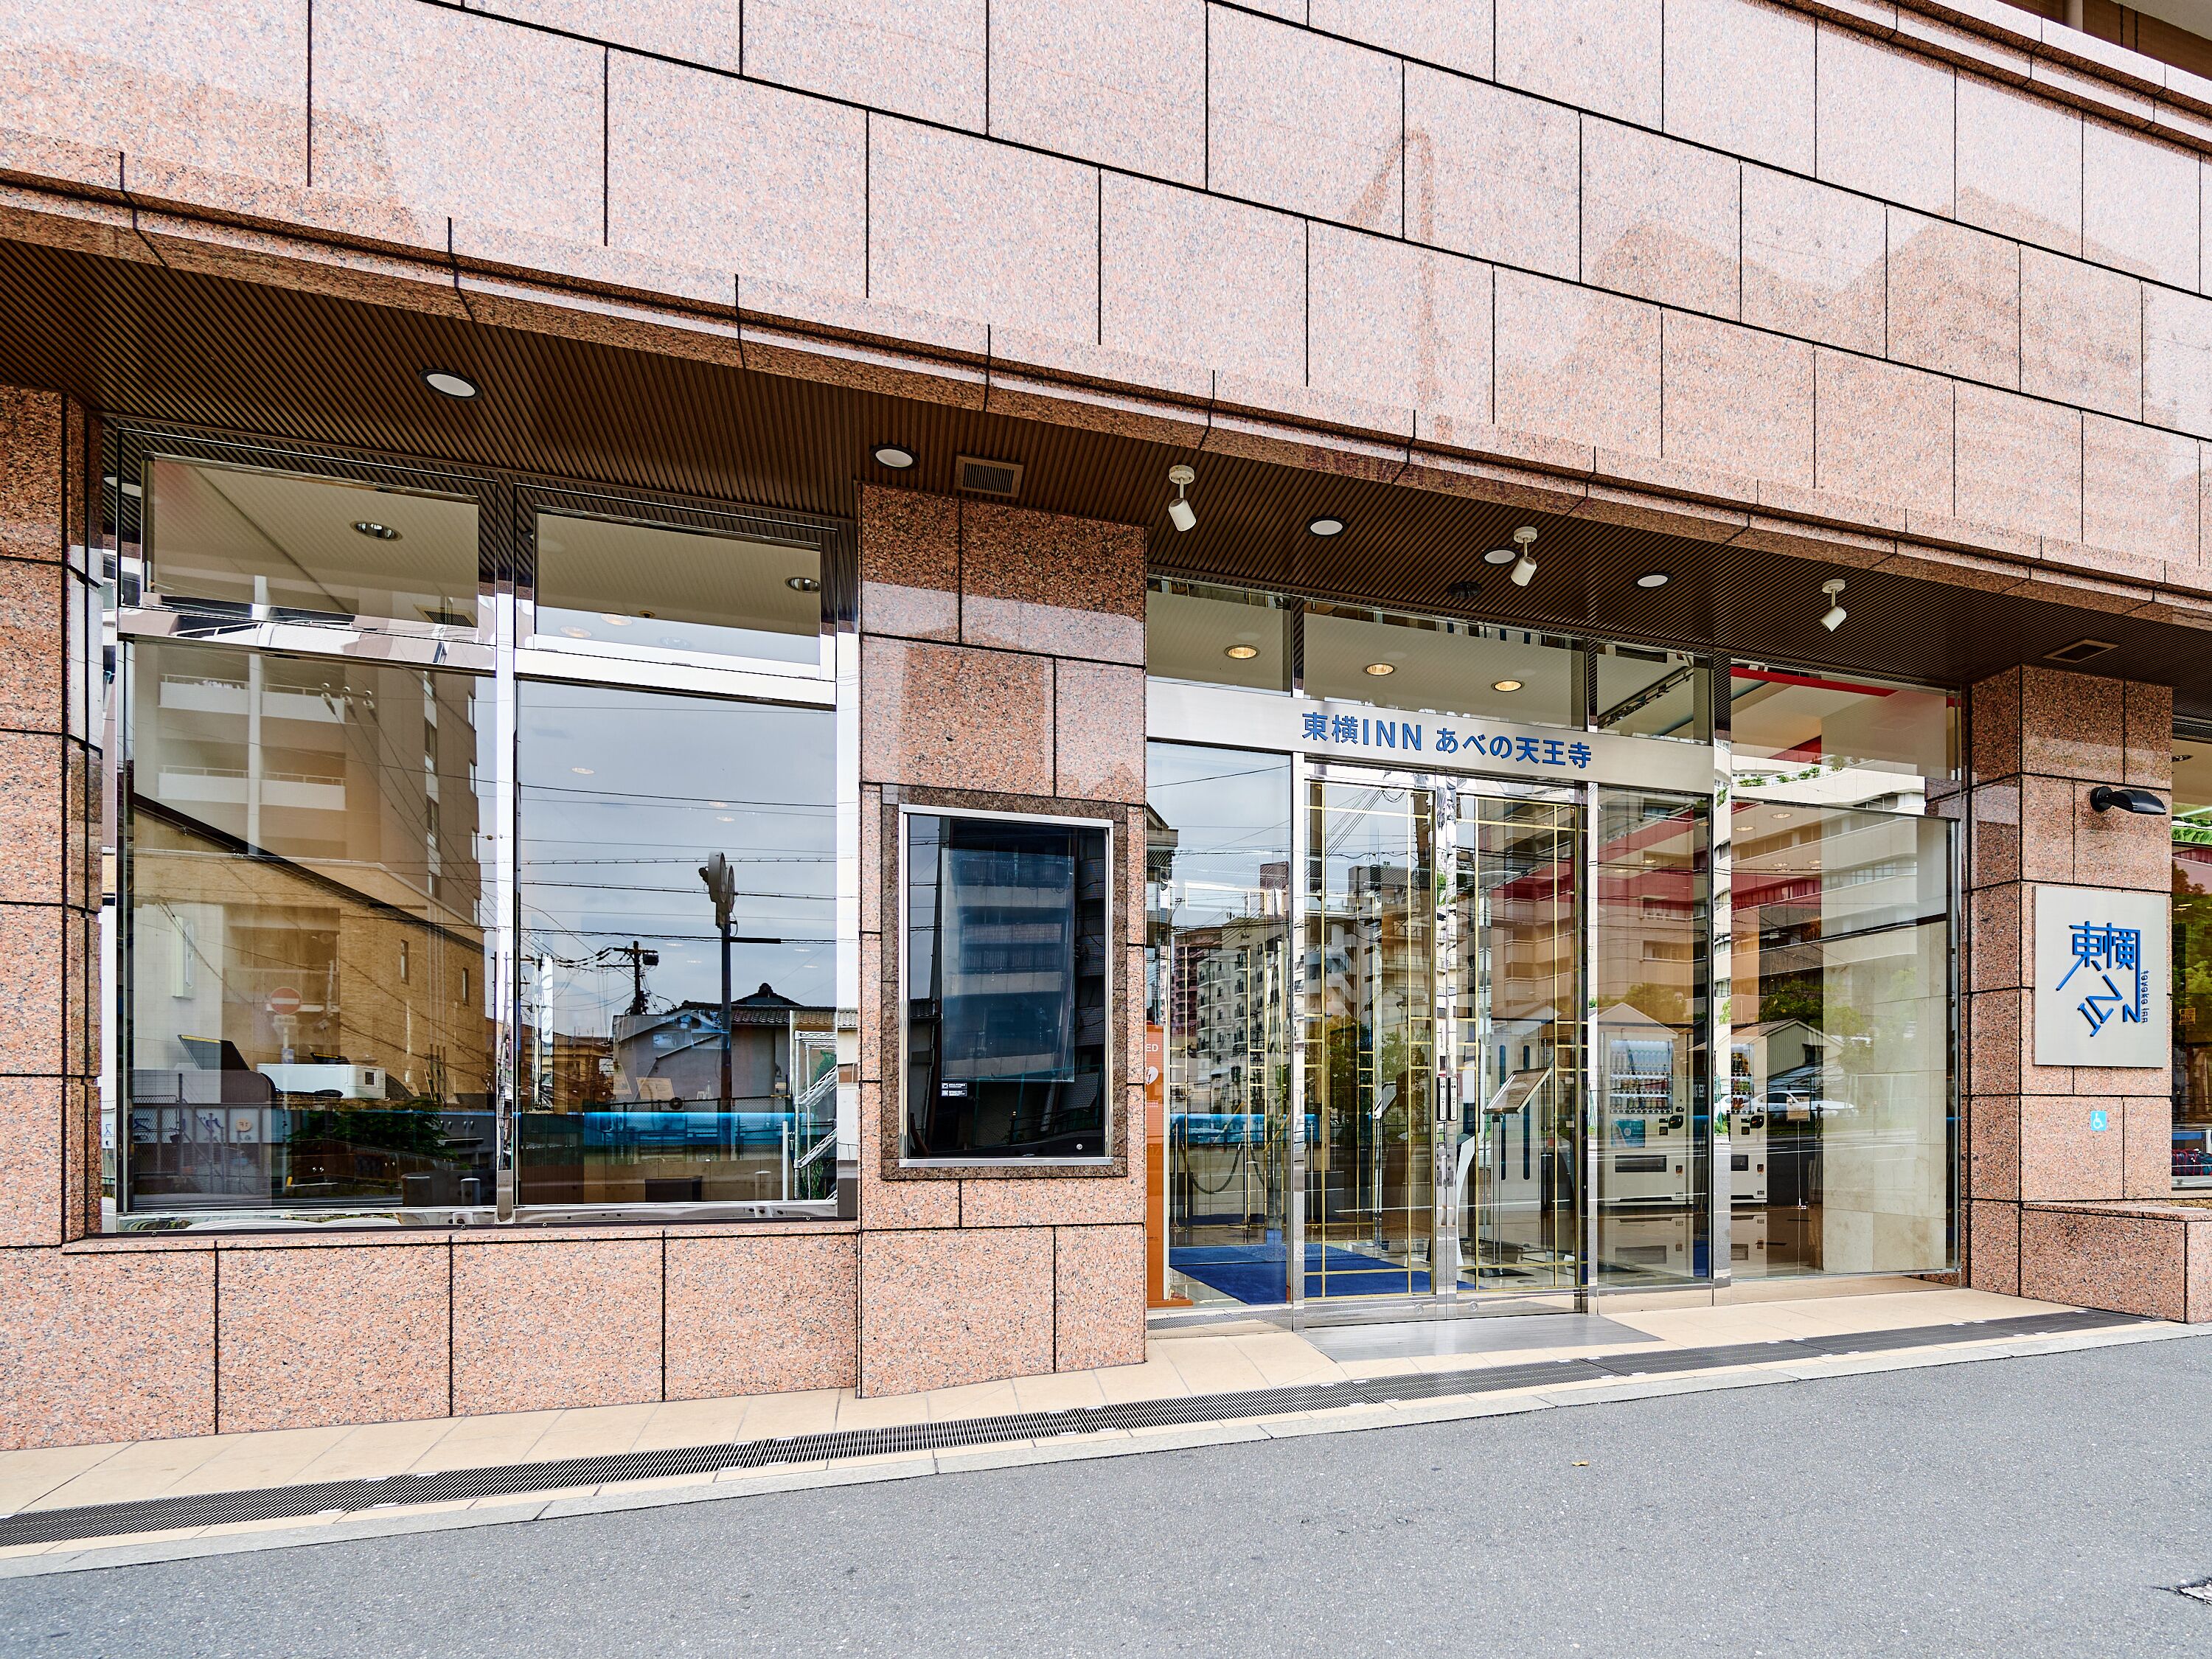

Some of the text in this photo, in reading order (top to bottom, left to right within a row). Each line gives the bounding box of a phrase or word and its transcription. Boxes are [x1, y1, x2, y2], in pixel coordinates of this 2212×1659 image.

[1302, 712, 1592, 768] 東横INN あべの天王寺
[1146, 1043, 1159, 1052] ED
